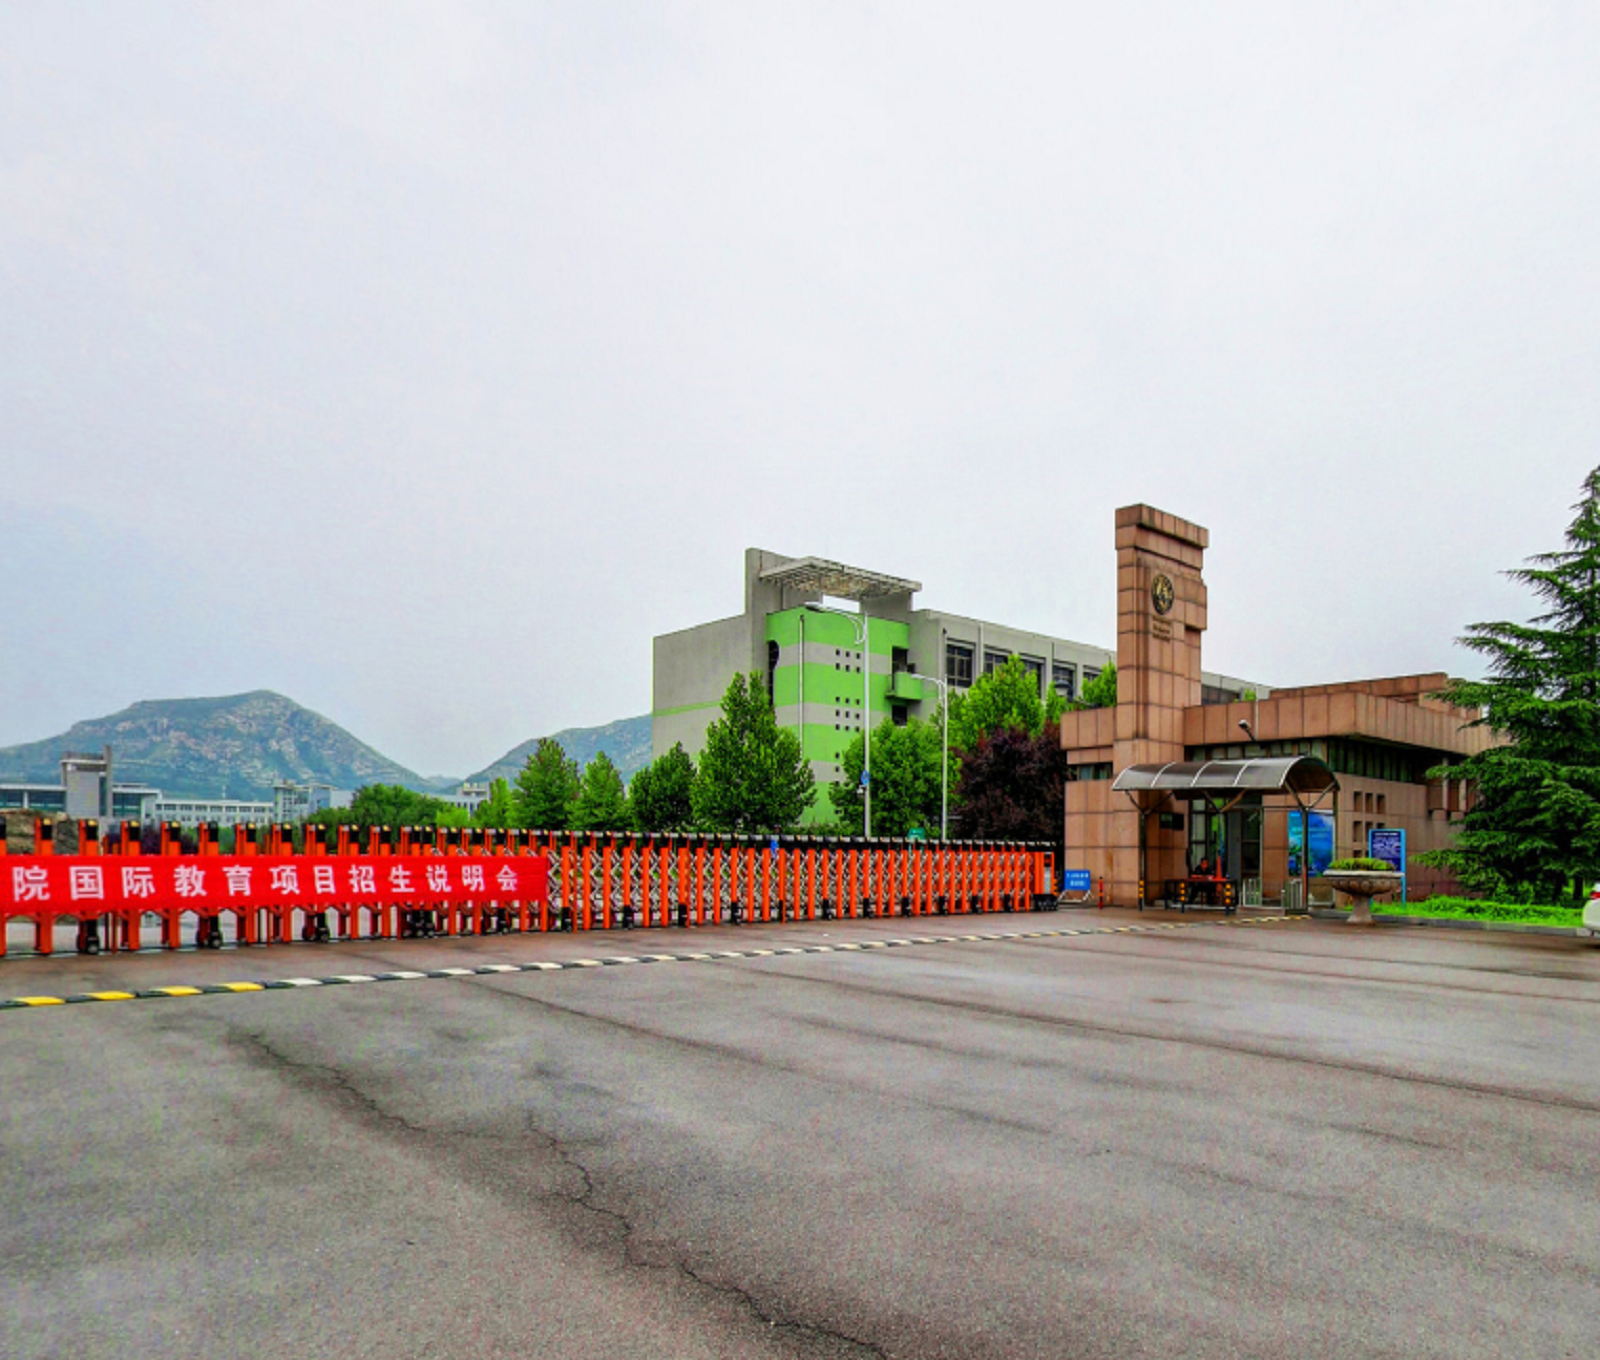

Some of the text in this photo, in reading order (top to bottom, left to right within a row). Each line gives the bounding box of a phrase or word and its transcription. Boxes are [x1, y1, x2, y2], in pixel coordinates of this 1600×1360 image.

[12, 864, 518, 901] 院国际教育项目招生说明会
